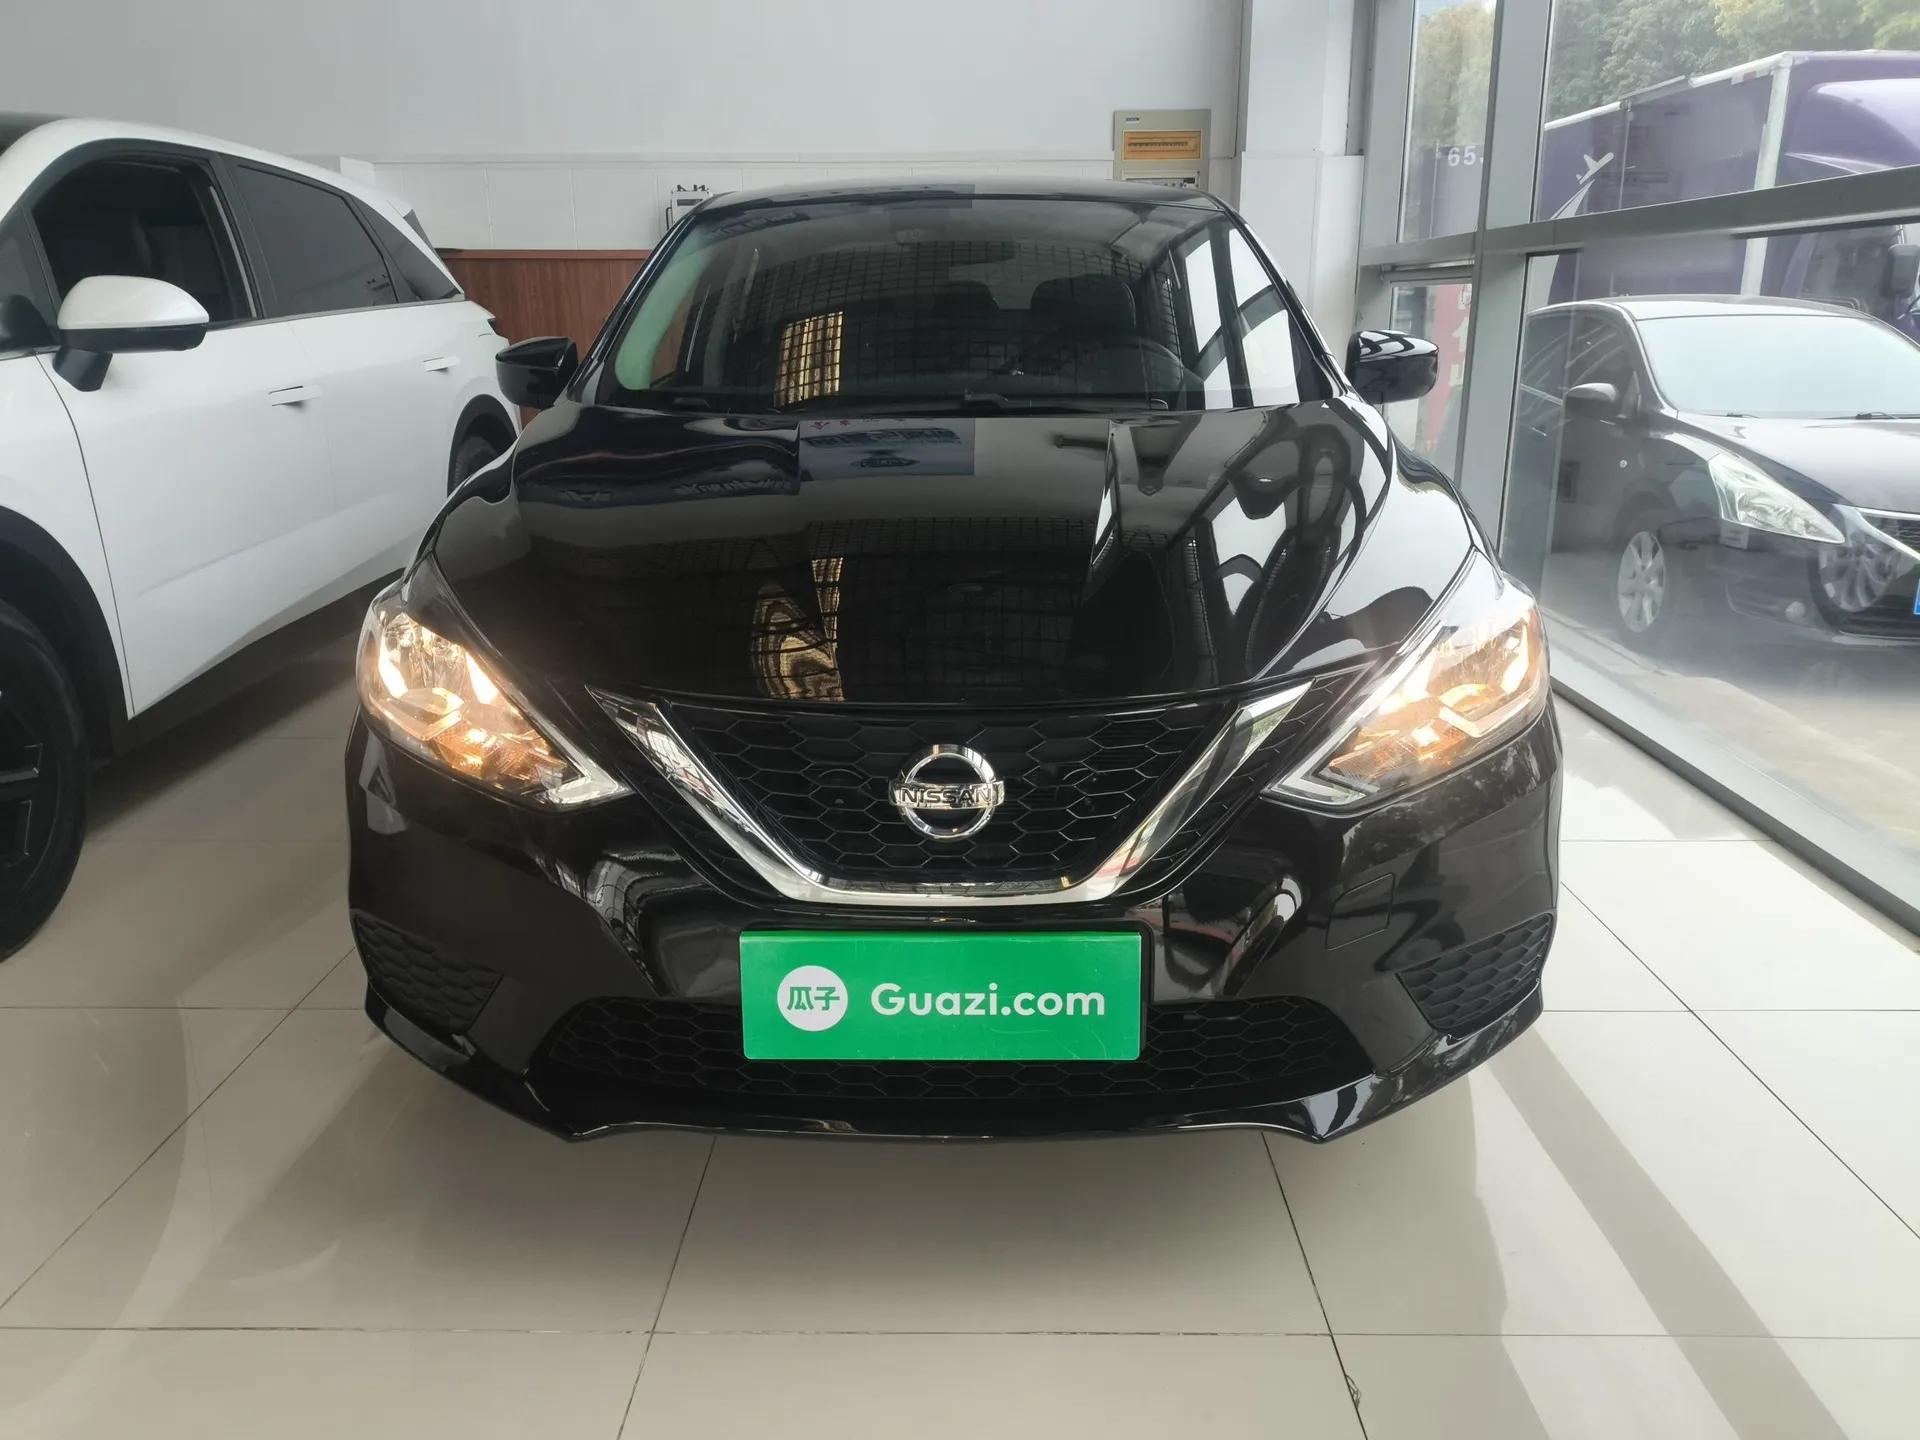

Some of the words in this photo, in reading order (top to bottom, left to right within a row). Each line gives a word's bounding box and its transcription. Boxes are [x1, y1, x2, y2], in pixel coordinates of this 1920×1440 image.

[1447, 145, 1484, 167] 65
[900, 786, 993, 806] NISSAN
[787, 986, 840, 1012] 瓜子
[870, 982, 1106, 1016] Guazi.com
